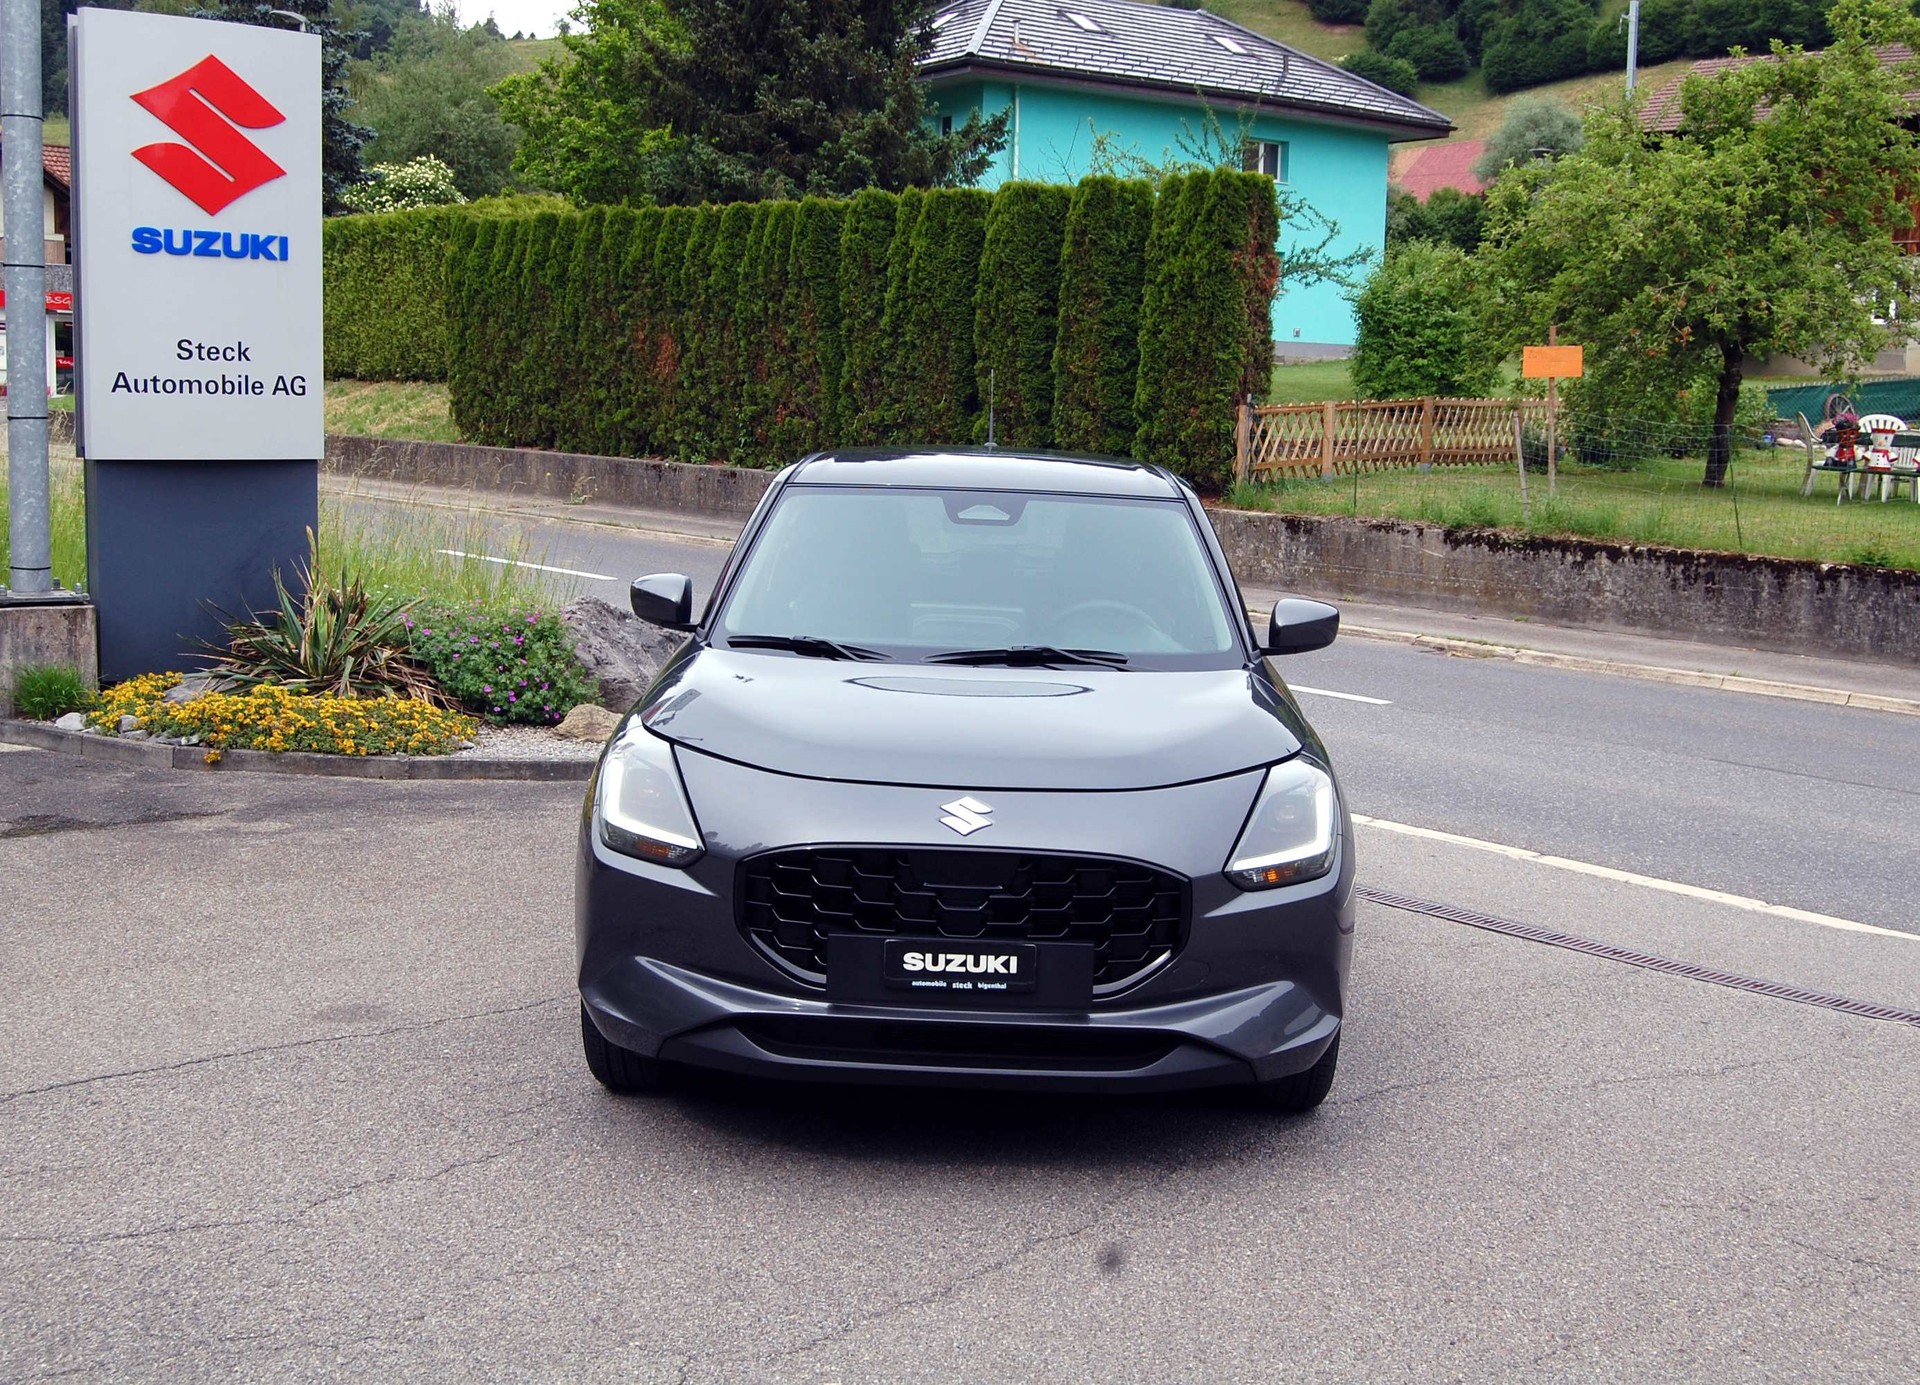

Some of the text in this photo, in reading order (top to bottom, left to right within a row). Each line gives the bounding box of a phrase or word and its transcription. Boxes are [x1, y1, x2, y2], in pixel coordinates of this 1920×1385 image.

[131, 226, 289, 261] SUZUKI
[176, 339, 251, 362] Steck
[111, 371, 307, 397] Automobile AG
[903, 952, 1017, 973] SUZUKI
[952, 981, 973, 989] steck
